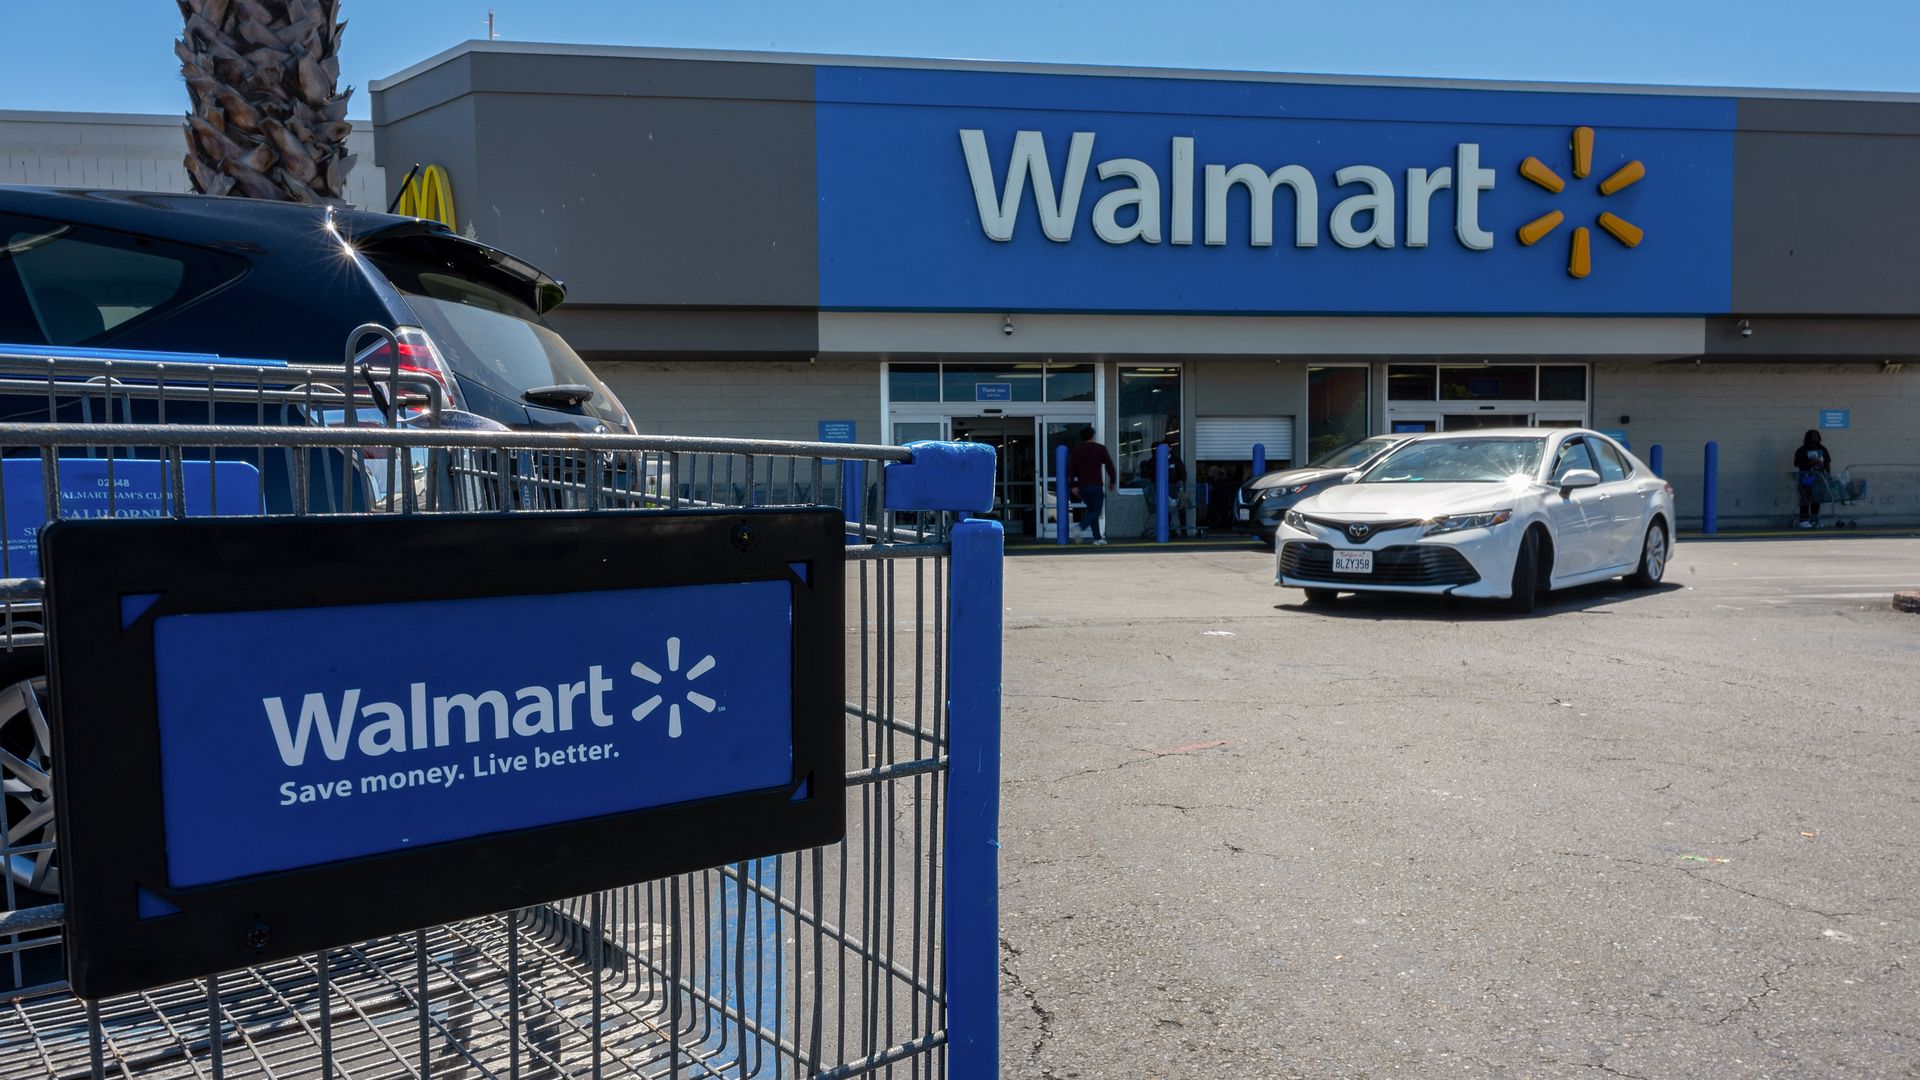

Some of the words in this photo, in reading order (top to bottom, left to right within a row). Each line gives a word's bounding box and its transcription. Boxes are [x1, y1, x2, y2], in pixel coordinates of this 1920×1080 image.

[959, 129, 1496, 250] Walmart
[60, 491, 109, 499] ALMART
[1335, 558, 1370, 569] 8LZY358
[262, 664, 614, 767] Walmart
[279, 779, 353, 806] Save
[360, 767, 466, 794] money.
[473, 753, 529, 778] Live
[534, 742, 621, 769] better.
